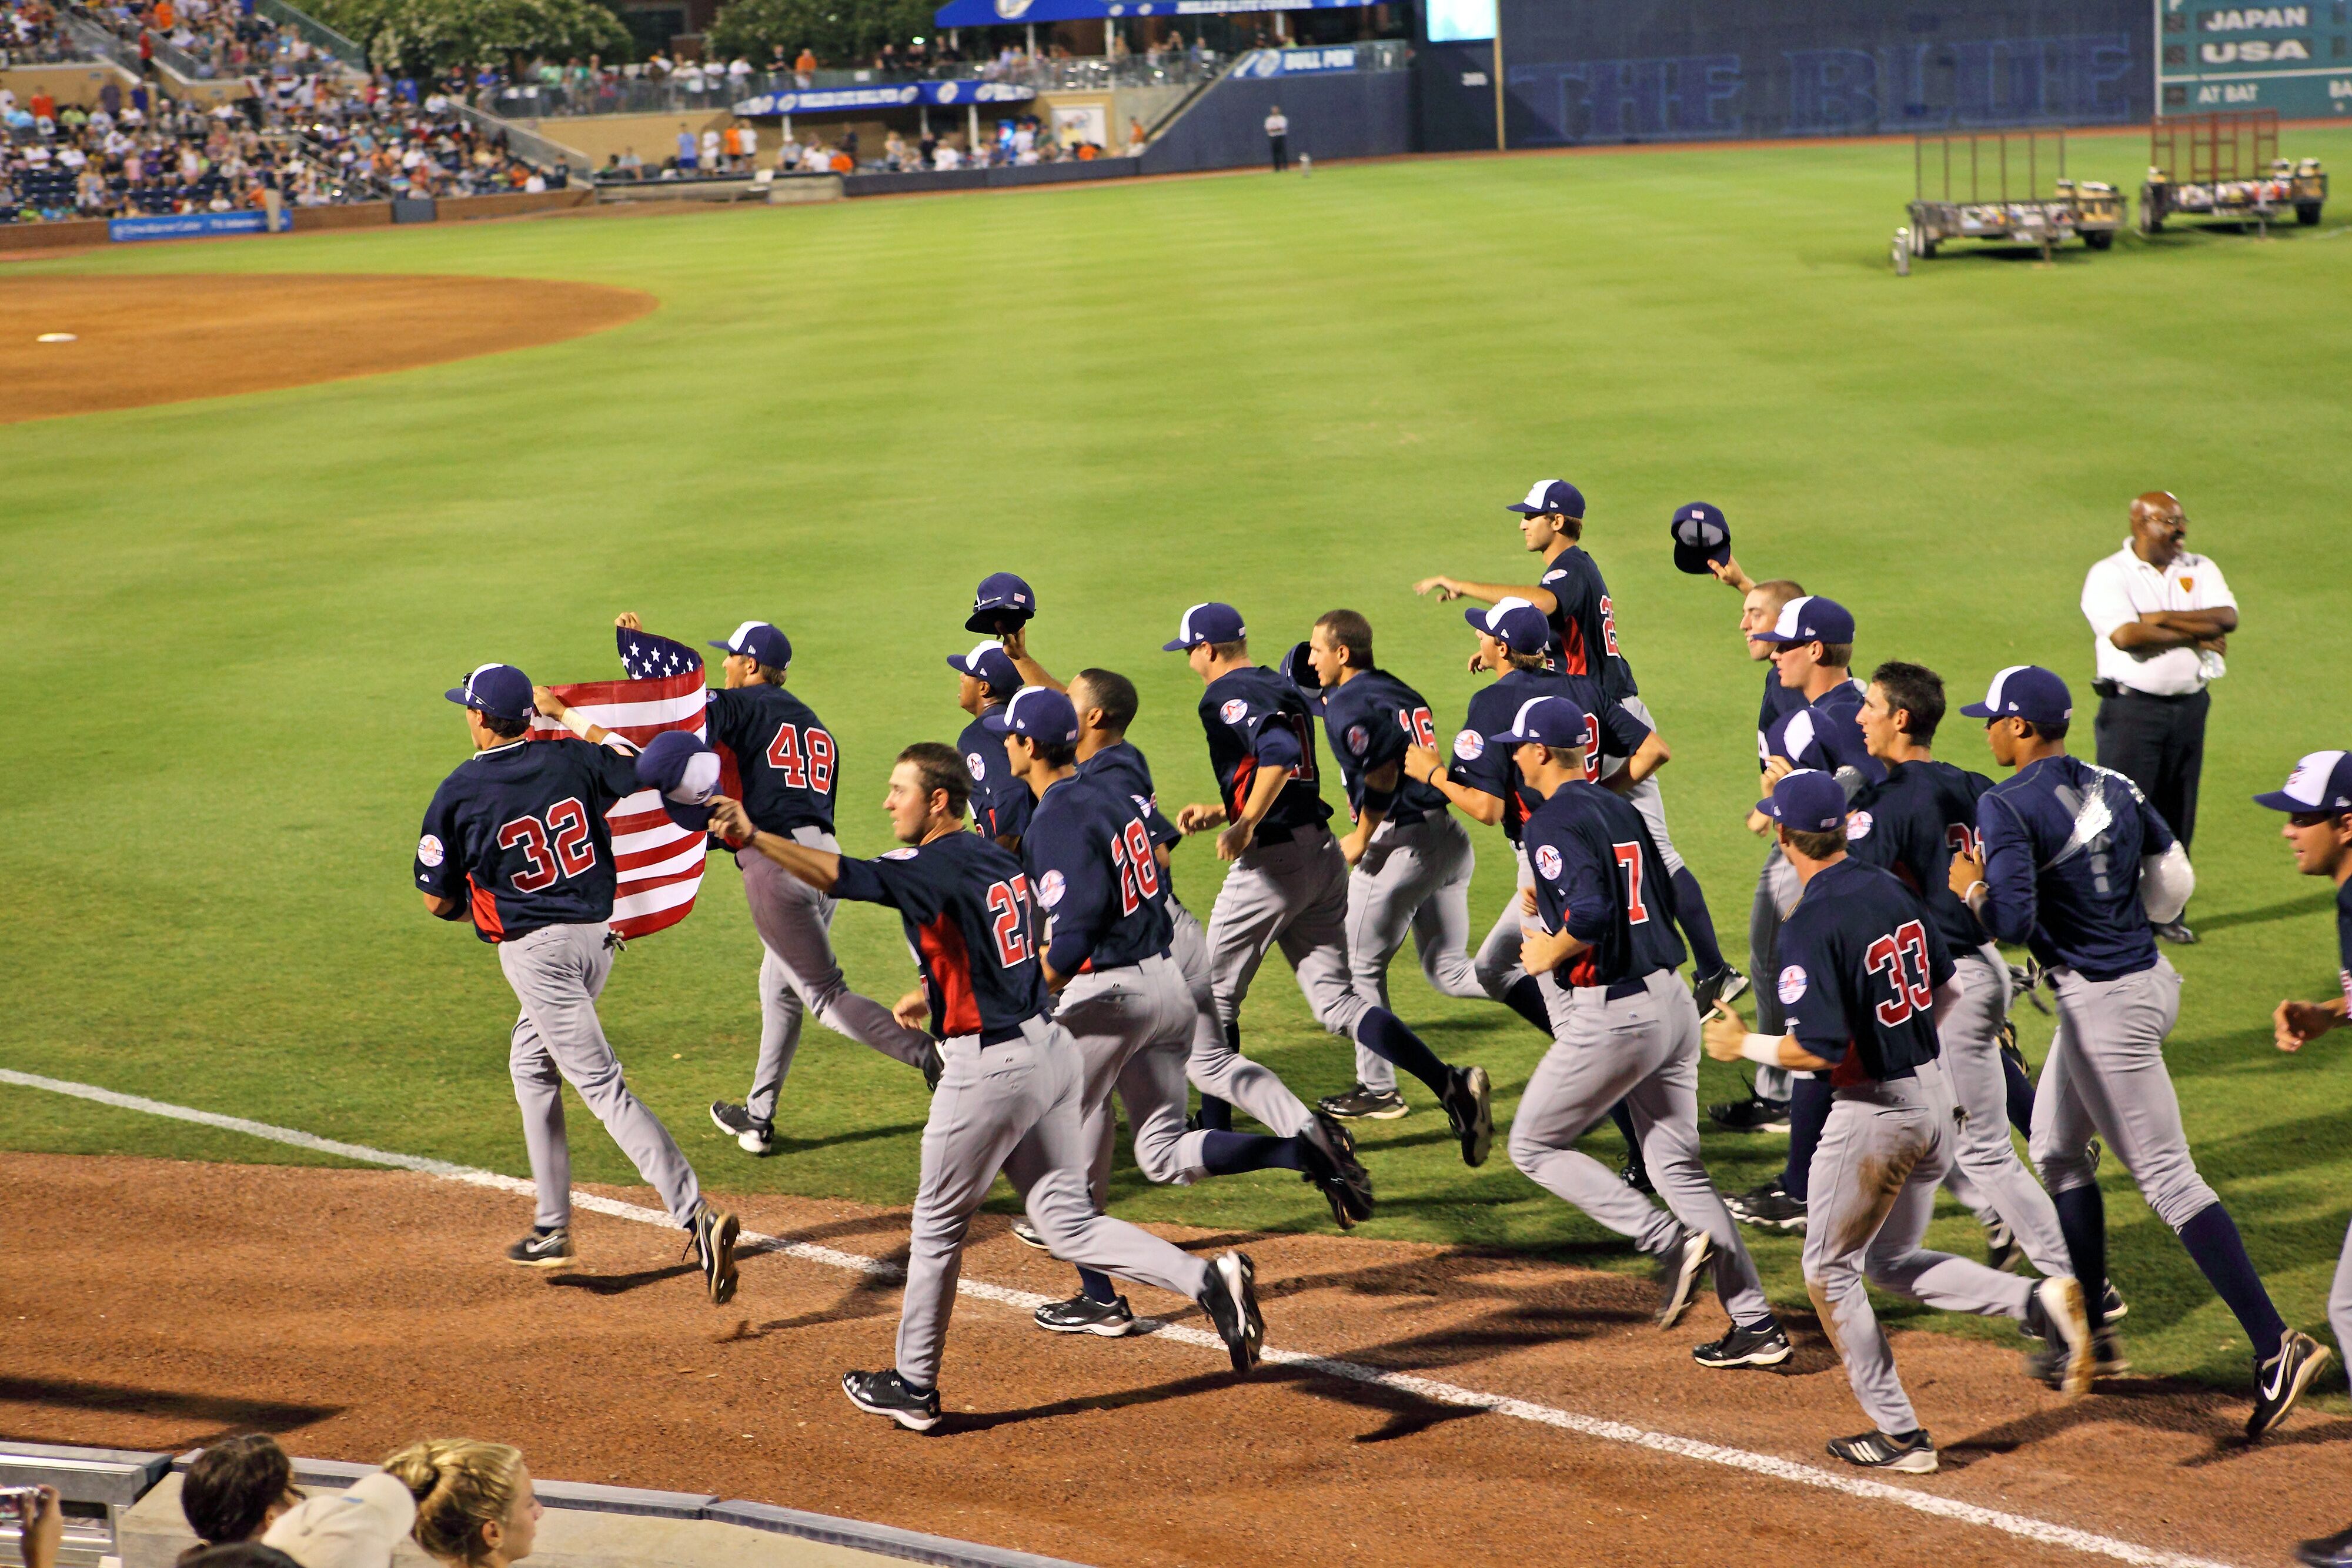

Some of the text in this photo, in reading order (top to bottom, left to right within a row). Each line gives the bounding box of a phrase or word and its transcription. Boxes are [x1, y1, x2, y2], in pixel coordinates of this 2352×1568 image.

[2201, 39, 2310, 63] USA
[2207, 6, 2307, 31] JAPAN
[1508, 55, 1745, 143] THE
[2198, 83, 2258, 103] AT BAT
[766, 723, 835, 795] 48
[497, 797, 596, 894] 32
[1110, 817, 1159, 917] 28
[1612, 841, 1649, 925] 7
[986, 872, 1035, 969] 27
[1863, 919, 1933, 1028] 33
